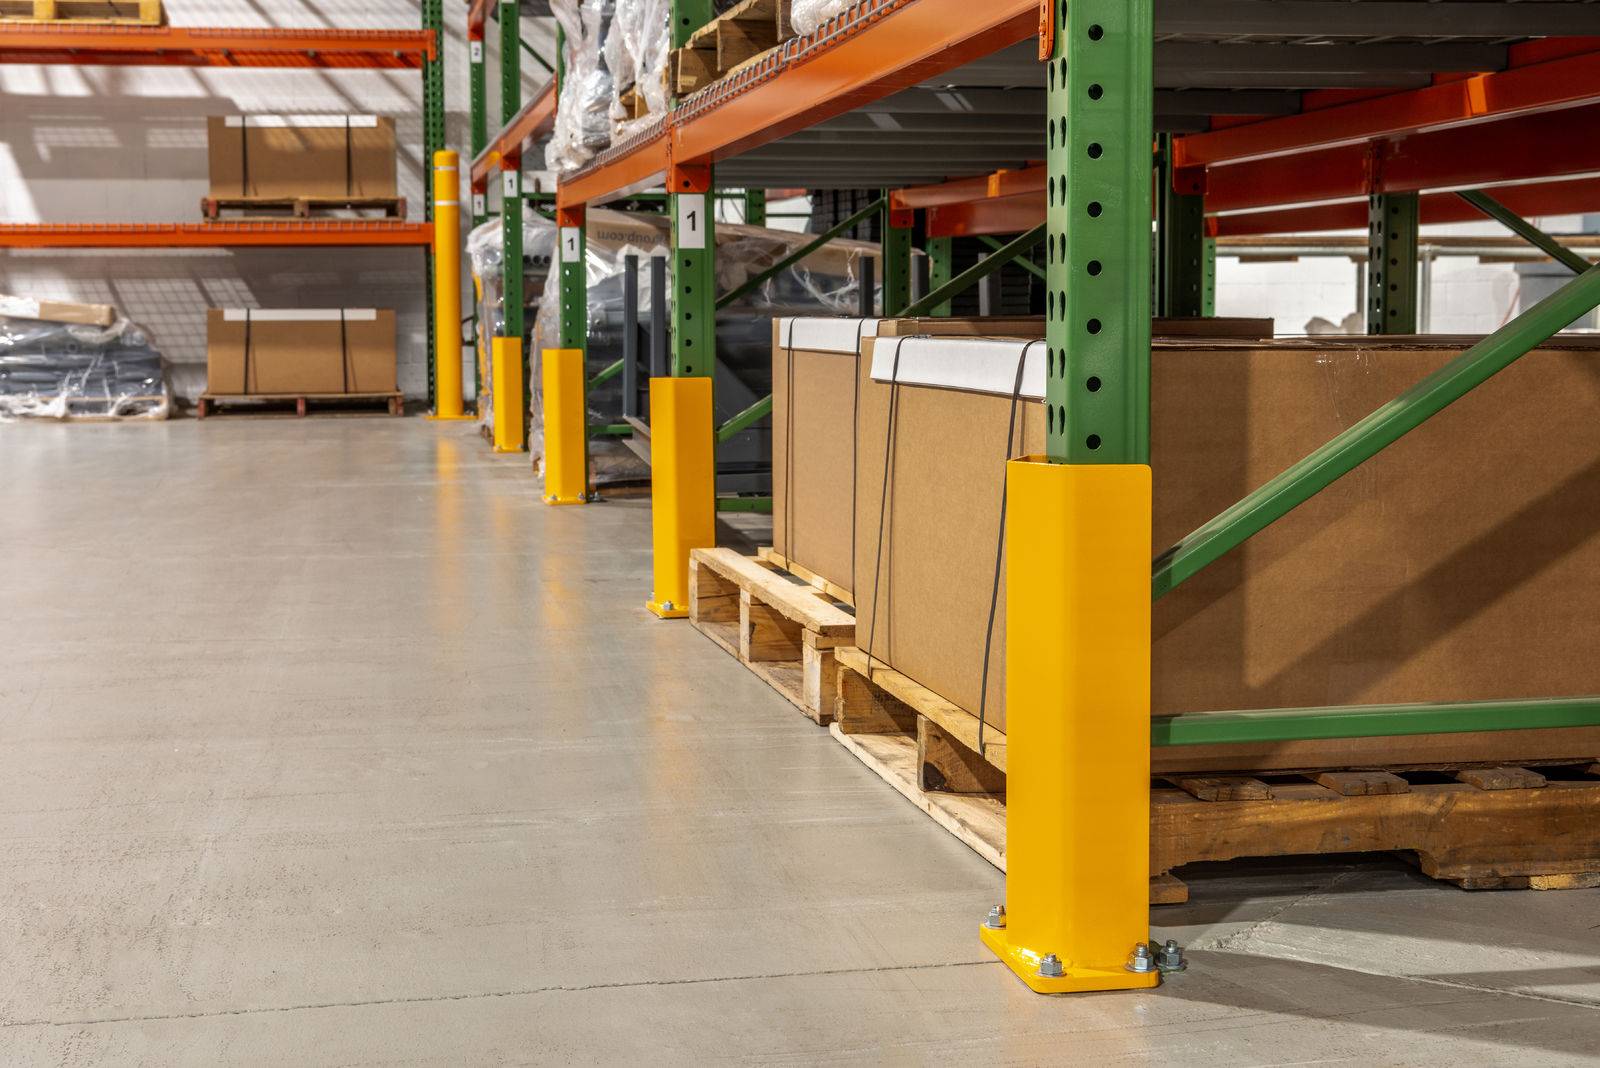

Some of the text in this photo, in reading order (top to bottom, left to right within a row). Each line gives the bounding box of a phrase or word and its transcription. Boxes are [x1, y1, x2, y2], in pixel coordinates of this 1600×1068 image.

[508, 178, 514, 189] 1
[686, 210, 696, 231] 1
[567, 237, 575, 251] 1
